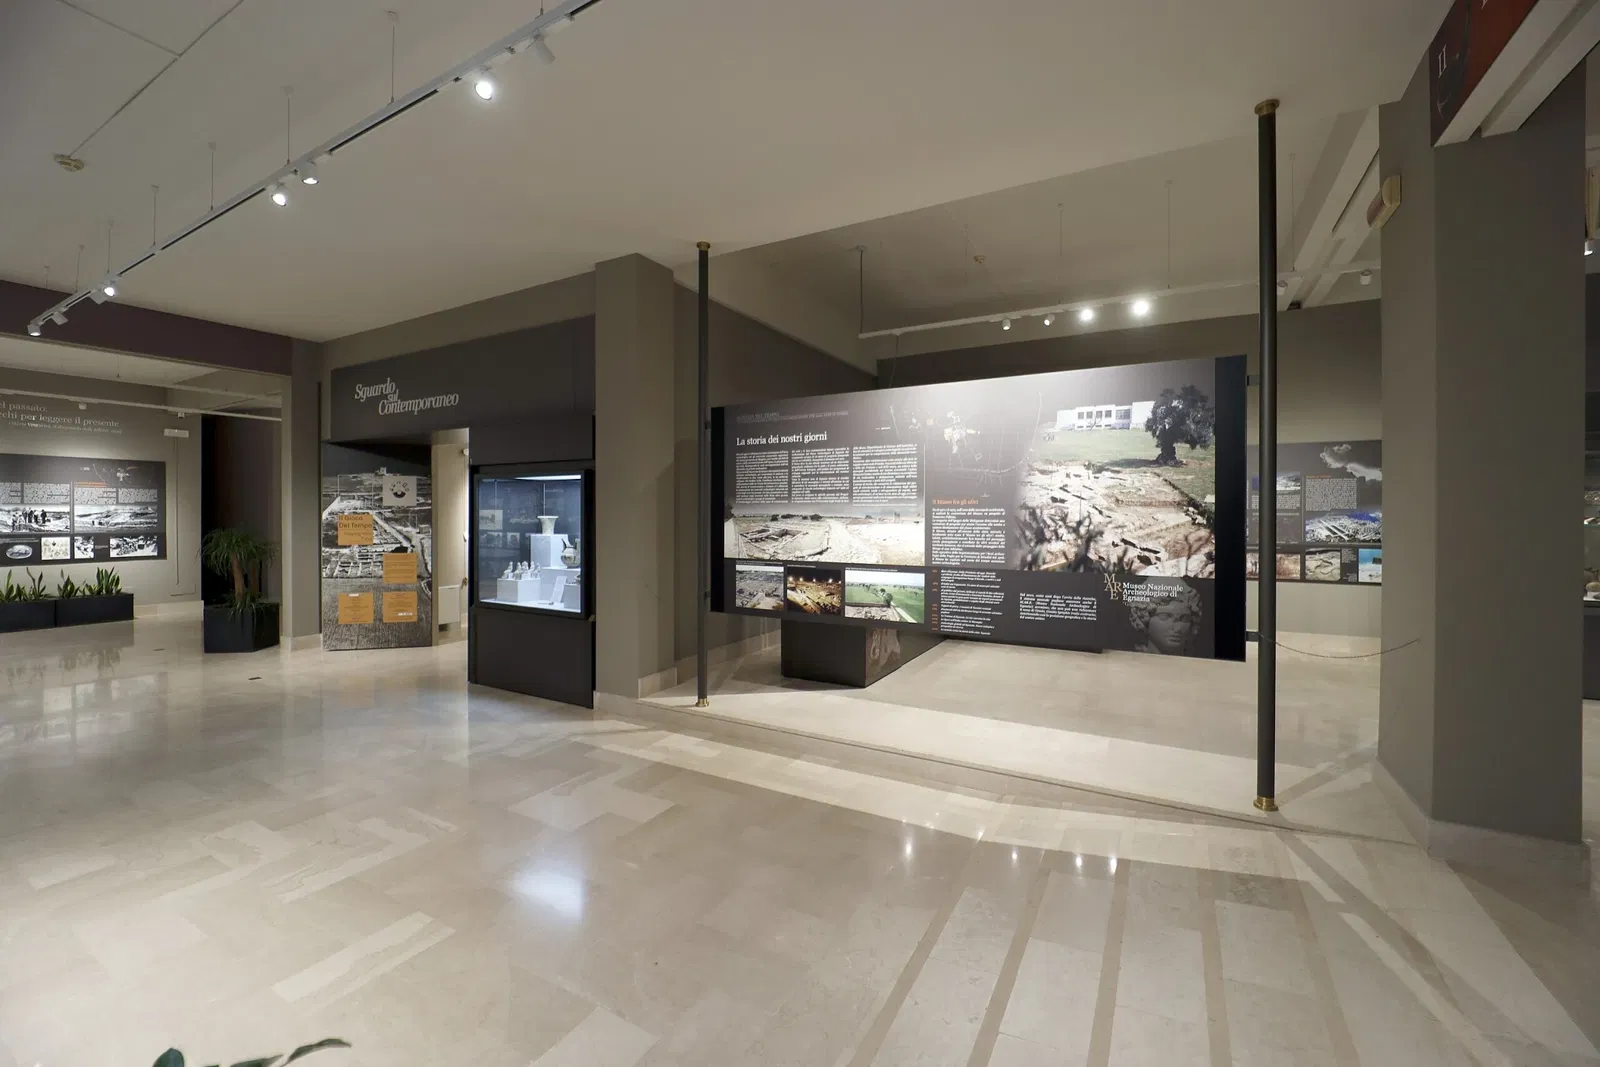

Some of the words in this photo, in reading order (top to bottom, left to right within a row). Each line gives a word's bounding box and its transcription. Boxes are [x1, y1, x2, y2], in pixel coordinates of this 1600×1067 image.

[355, 378, 396, 402] Sguardo
[387, 389, 399, 402] sul
[379, 394, 459, 415] Contemporaneo
[20, 413, 37, 421] per
[39, 413, 73, 424] leggere
[74, 416, 81, 424] il
[83, 418, 120, 428] presente
[736, 437, 746, 446] La
[746, 435, 767, 445] storia
[767, 434, 779, 443] dei
[780, 432, 803, 443] nostri
[804, 431, 827, 443] giorni
[351, 522, 373, 530] Tempo
[1122, 582, 1146, 590] Museo
[1147, 583, 1184, 592] Nazionale
[1122, 589, 1169, 598] Archeologico
[1169, 590, 1178, 598] di
